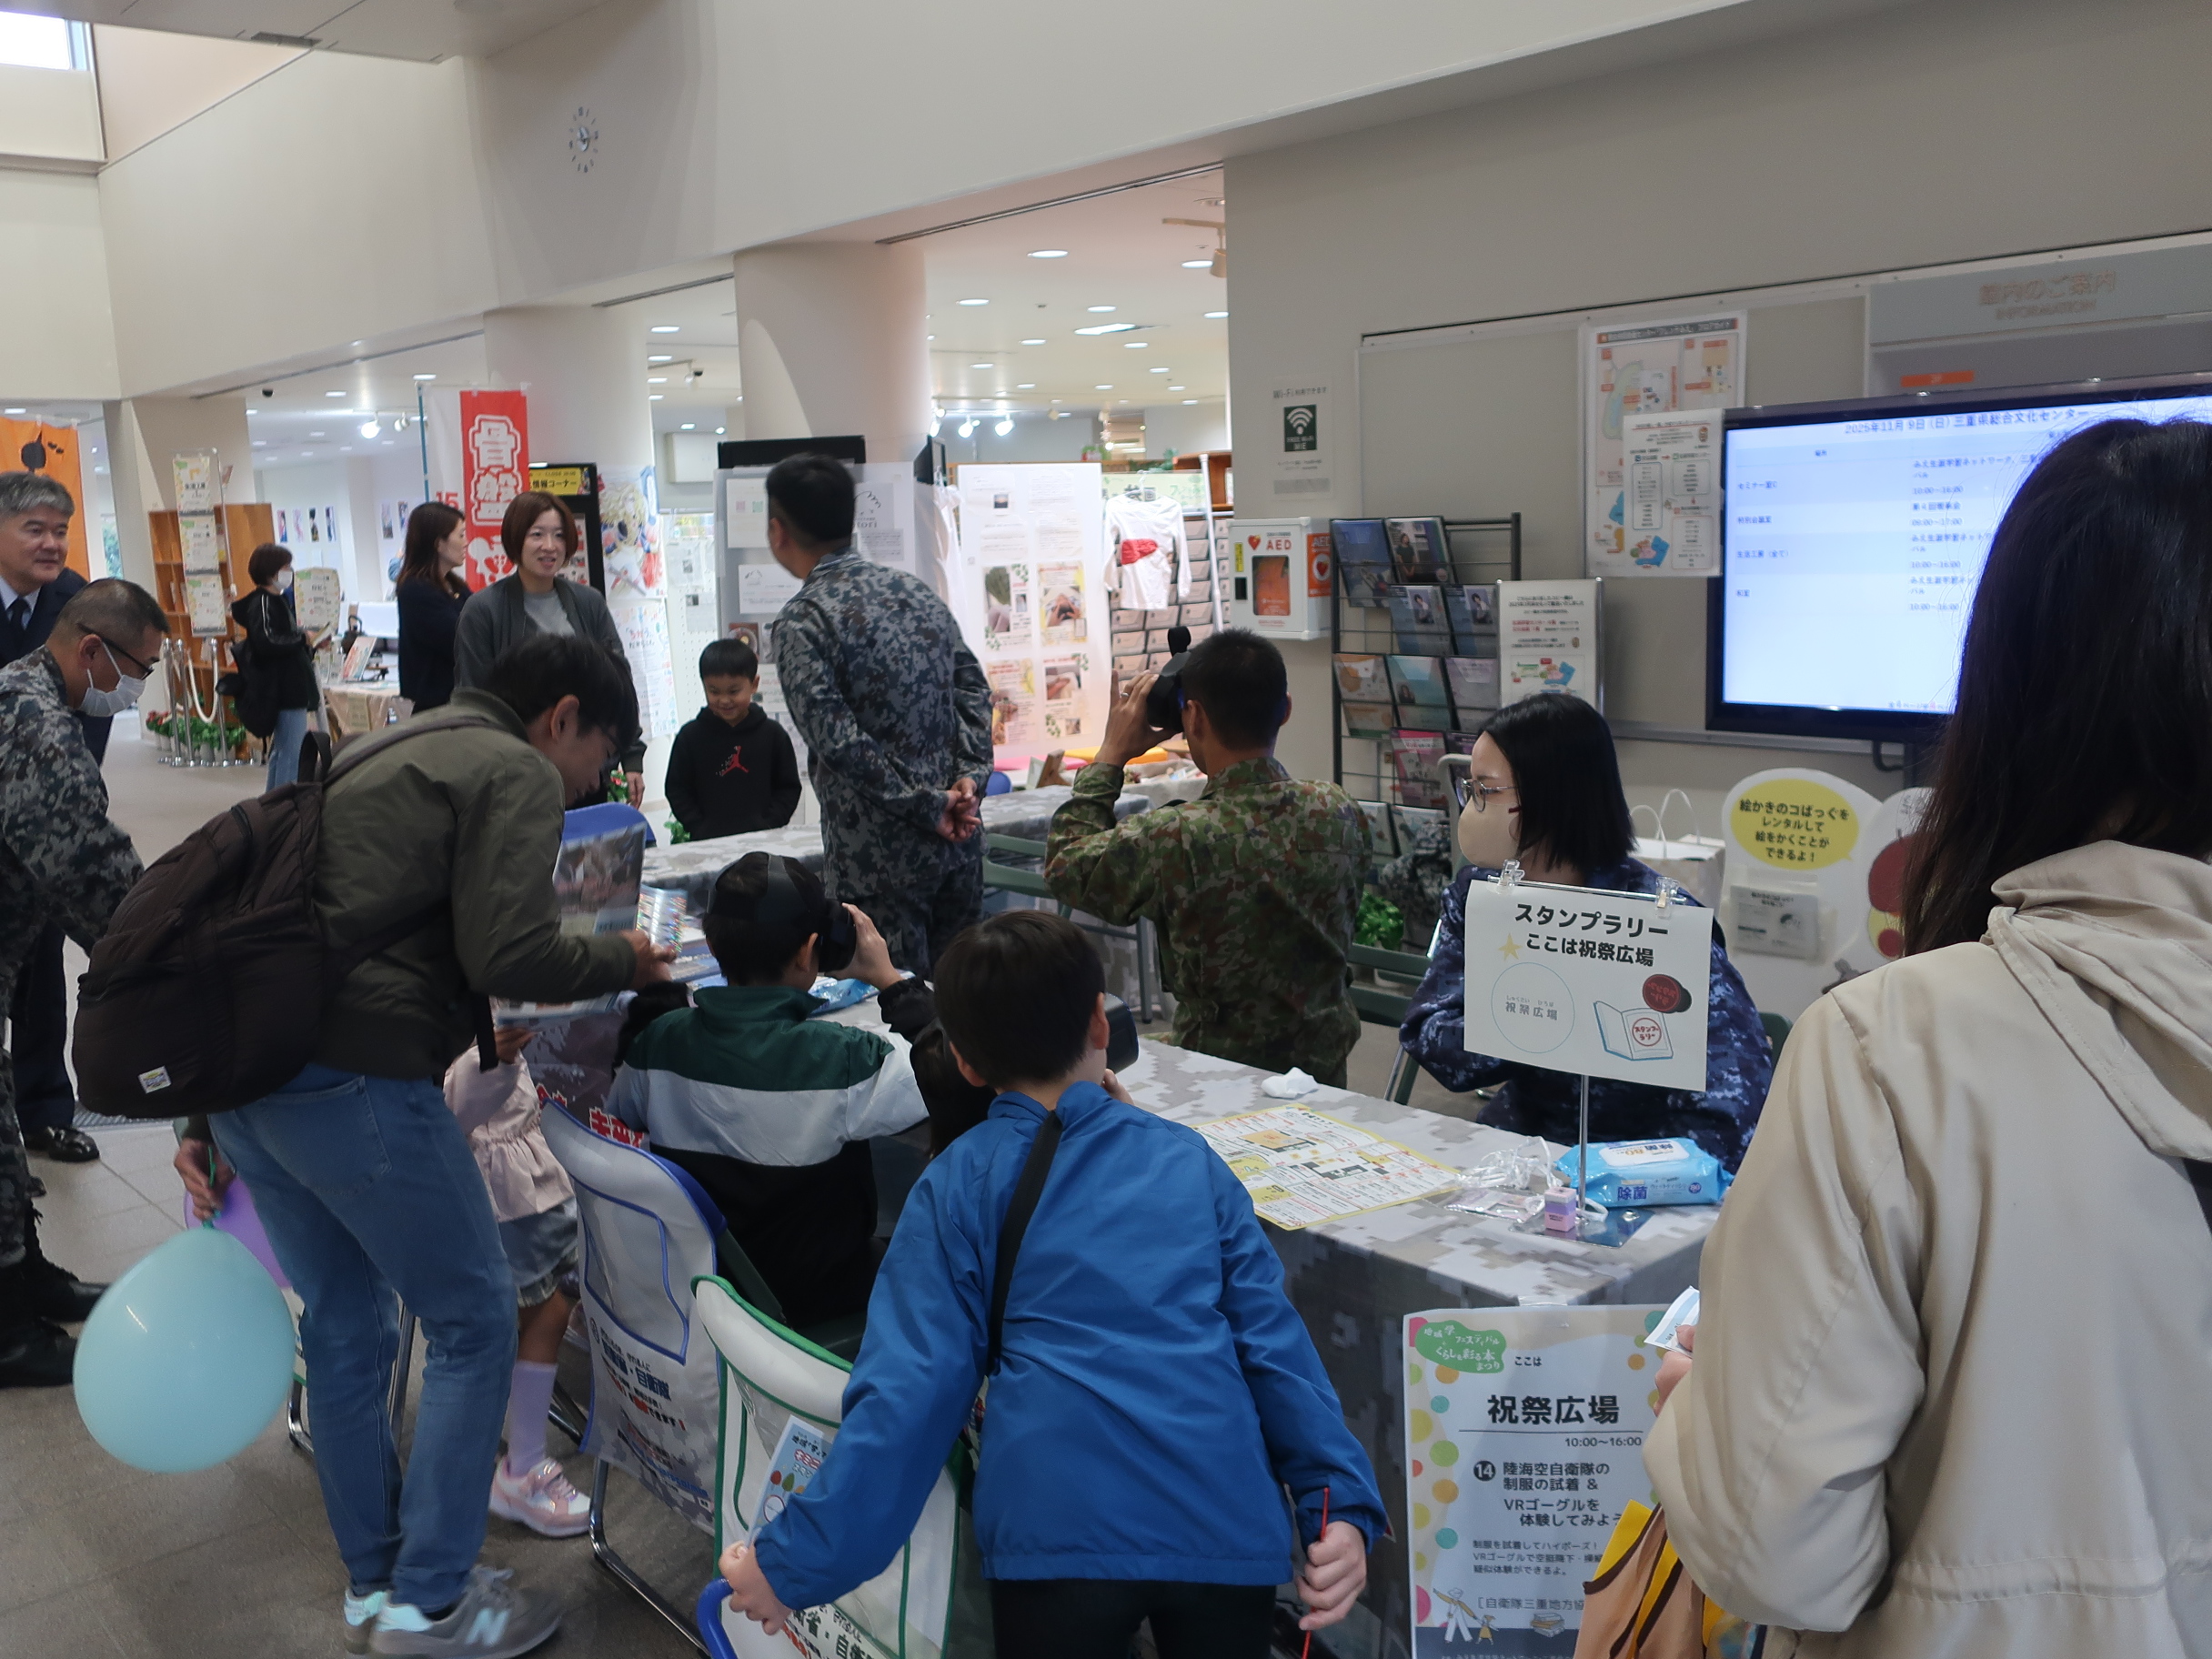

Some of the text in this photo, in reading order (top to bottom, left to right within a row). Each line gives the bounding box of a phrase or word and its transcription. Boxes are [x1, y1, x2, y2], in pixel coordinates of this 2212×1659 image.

[529, 479, 577, 488] 情報コーナー
[1266, 539, 1292, 550] AED
[1763, 817, 1825, 832] レンタルして
[1755, 830, 1830, 849] 絵をかくことが
[1766, 848, 1815, 862] できるよ！
[1514, 902, 1669, 938] スタンプラリー
[1526, 932, 1654, 967] ここは祝祭広場
[1505, 1001, 1558, 1021] 祝祭広場
[1617, 1186, 1647, 1201] 除菌
[1476, 1362, 1501, 1371] まつり
[1514, 1356, 1543, 1366] ここは
[1487, 1394, 1620, 1424] 祝祭広場
[1503, 1462, 1610, 1476] 陸海空自衛隊の
[1503, 1478, 1599, 1491] 制服の試着 &
[1503, 1499, 1600, 1512] VRゴーグルを
